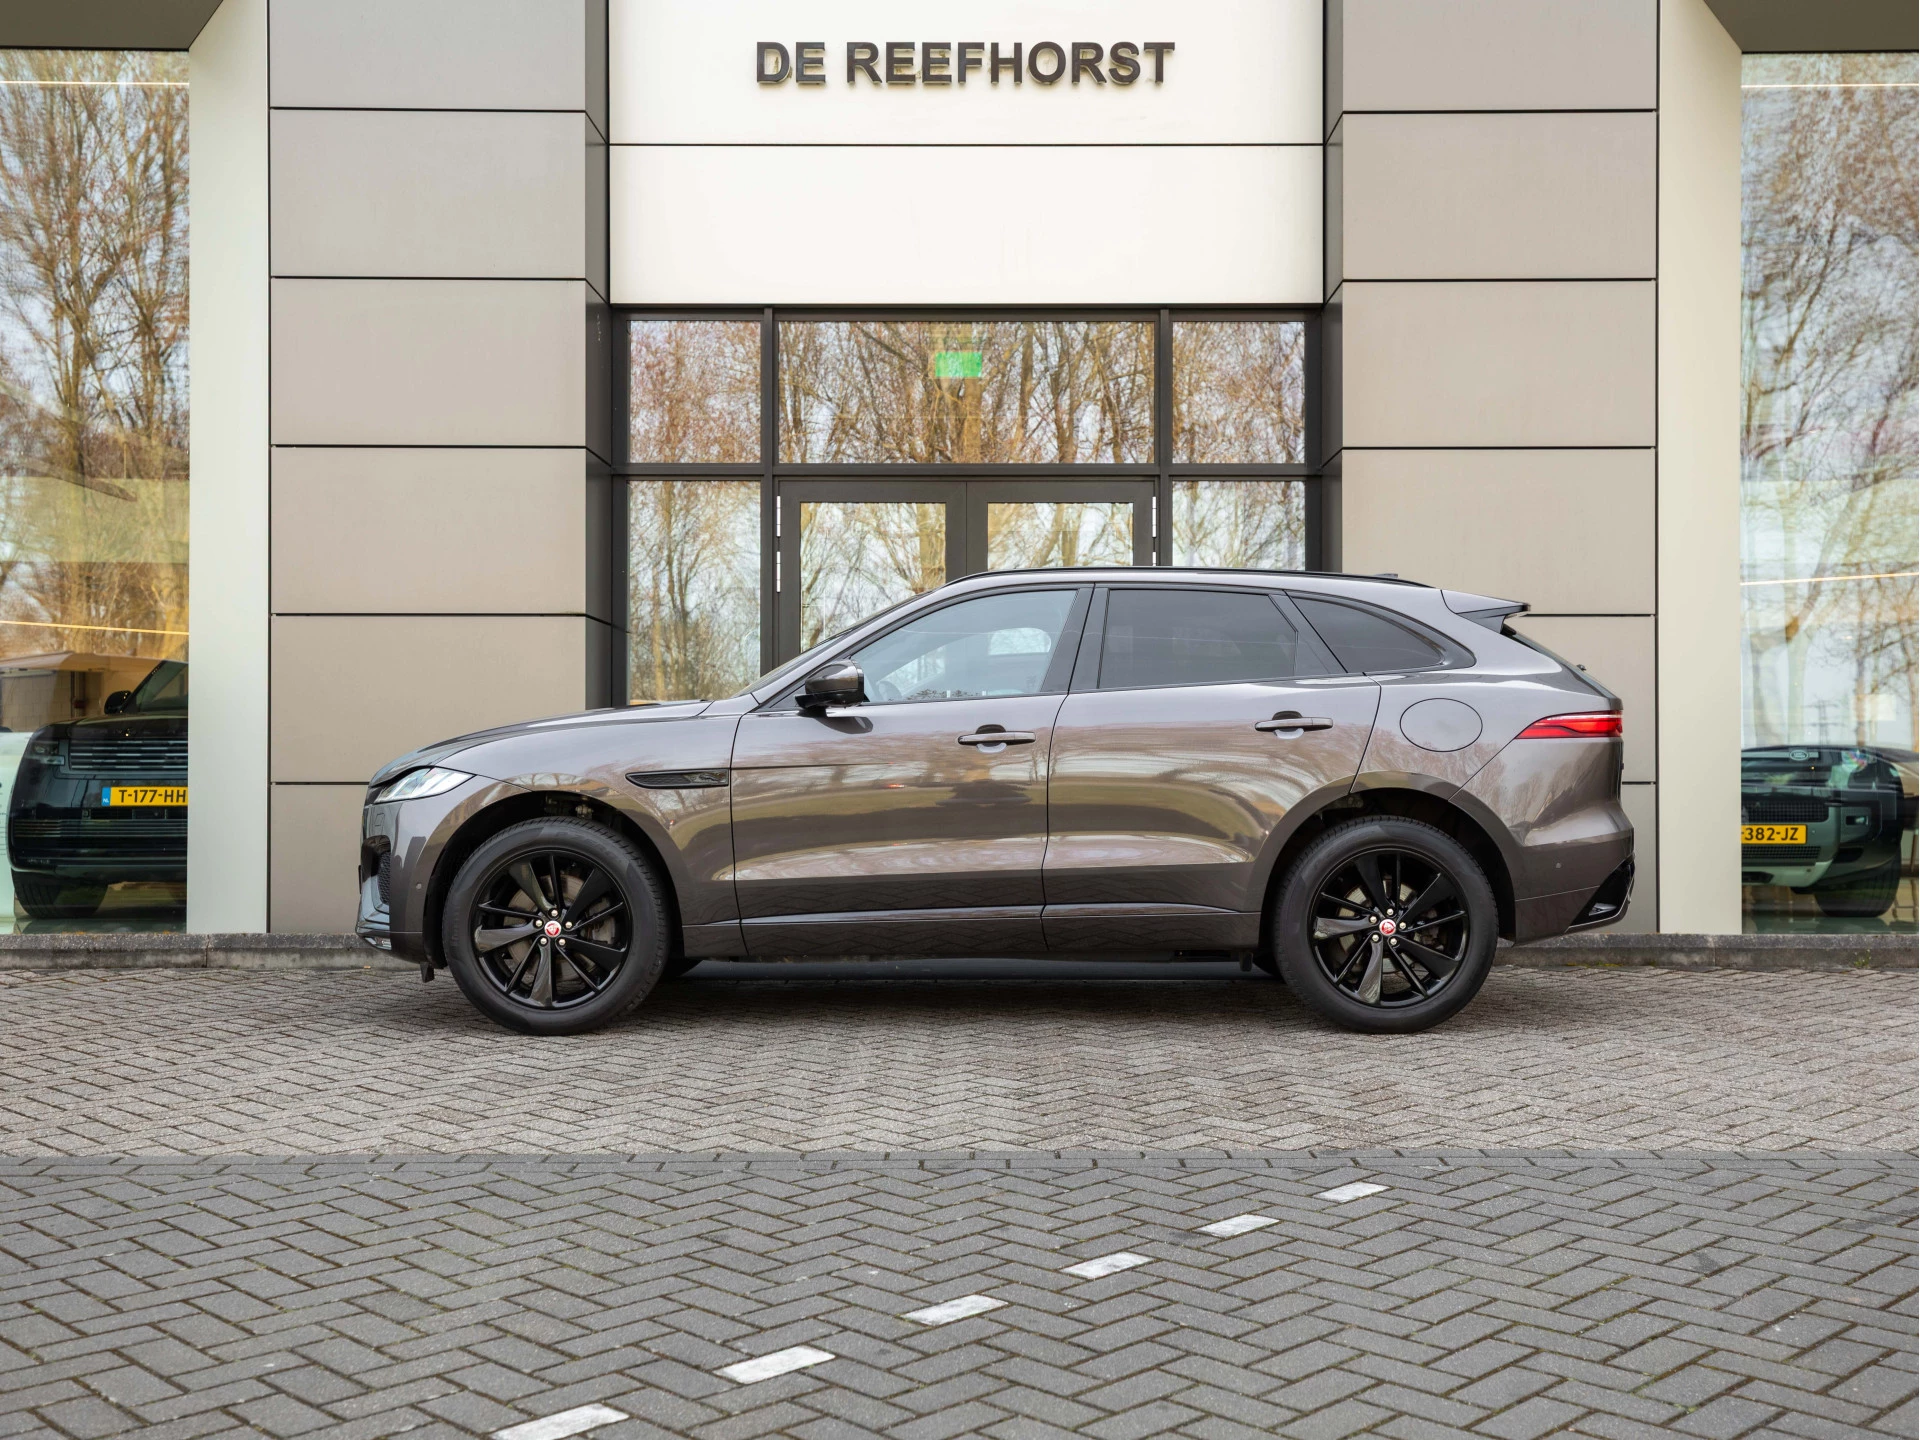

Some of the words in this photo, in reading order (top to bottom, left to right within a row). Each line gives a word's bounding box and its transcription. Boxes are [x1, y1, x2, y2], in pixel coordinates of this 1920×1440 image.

[757, 41, 826, 84] DE
[846, 41, 1175, 84] REEFHORST
[119, 789, 186, 803] T-177-HH
